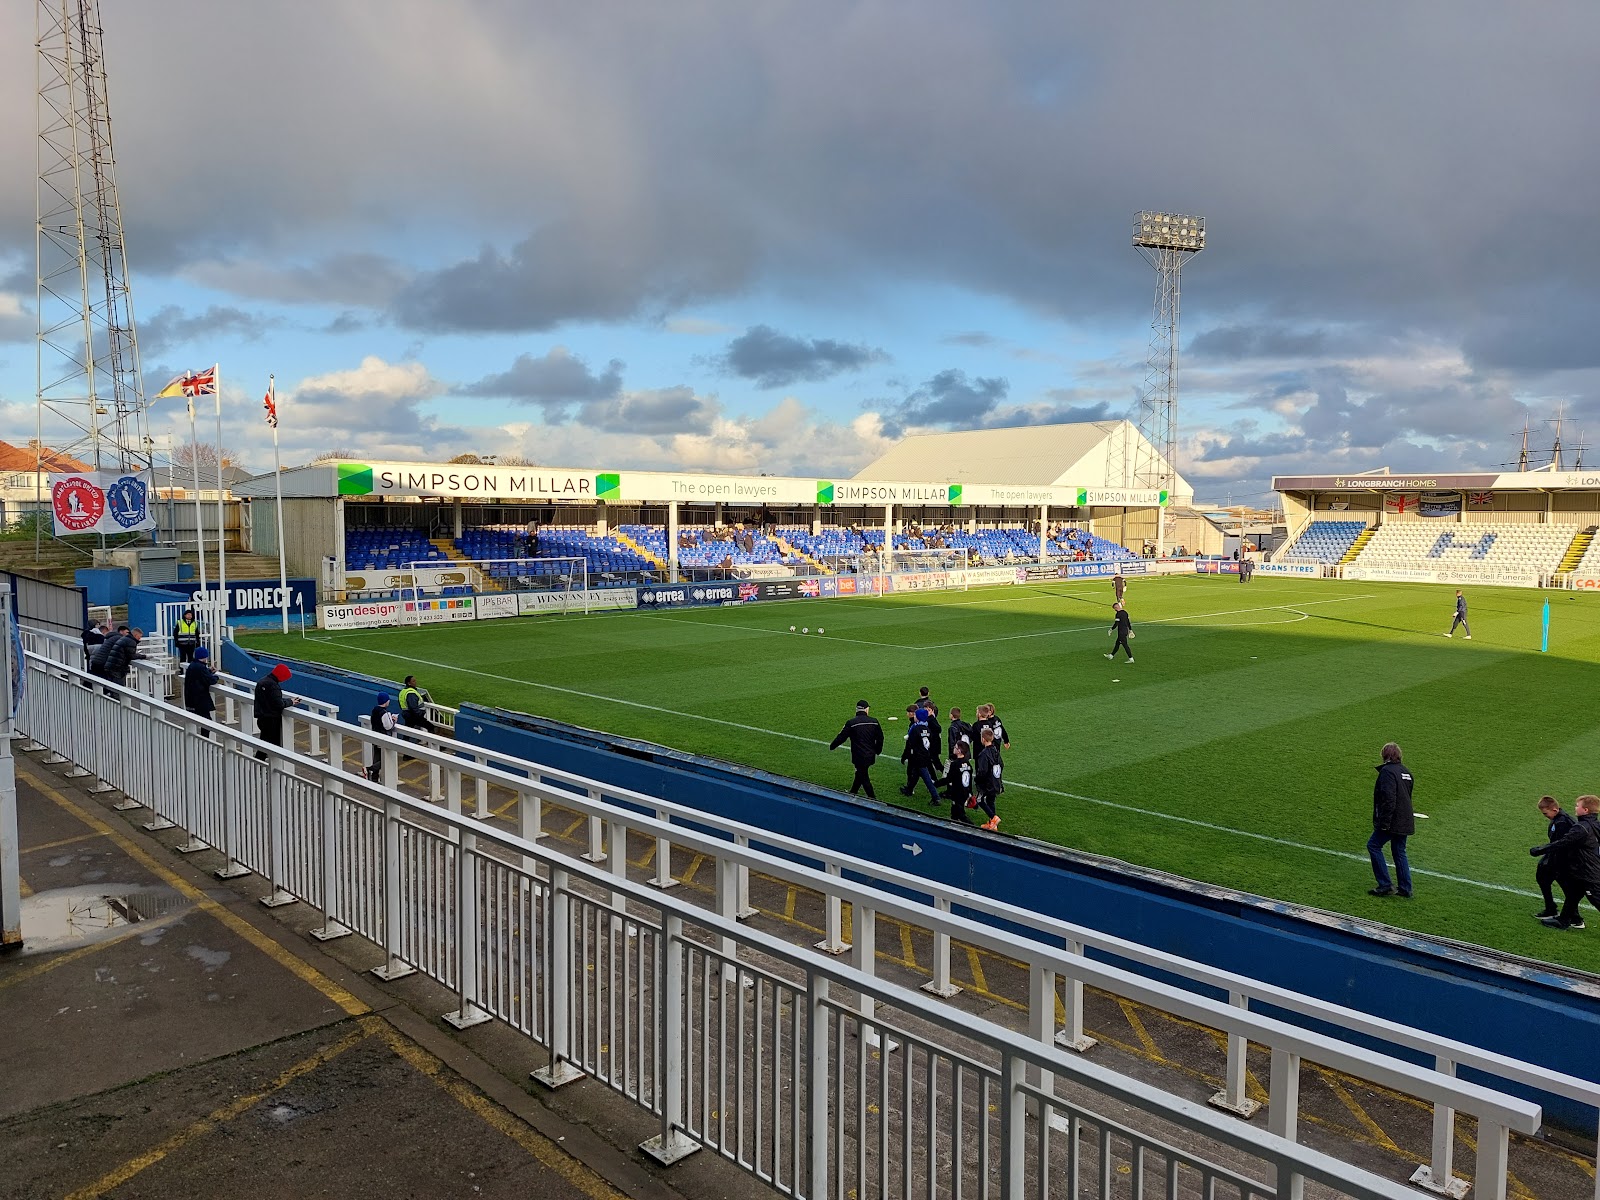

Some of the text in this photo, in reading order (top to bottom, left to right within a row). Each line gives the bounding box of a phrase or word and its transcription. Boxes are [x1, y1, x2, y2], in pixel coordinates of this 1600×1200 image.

[381, 472, 590, 493] SIMPSON MILLAR
[672, 480, 777, 497] The open lawyers
[1347, 480, 1405, 488] LONGBRANCH
[837, 486, 946, 500] SIMPSON MILLAR
[991, 489, 1053, 501] The open lawyers
[1089, 492, 1158, 503] SIMPSON MILLAR
[1480, 572, 1495, 580] Bell
[1497, 573, 1533, 581] Funerals
[840, 580, 854, 589] bet
[859, 580, 888, 590] sky bt
[193, 586, 293, 610] SUIT DIRECT
[656, 590, 685, 602] errea
[706, 587, 733, 600] errea
[482, 596, 512, 606] JP's BAR
[327, 604, 395, 619] signdesign
